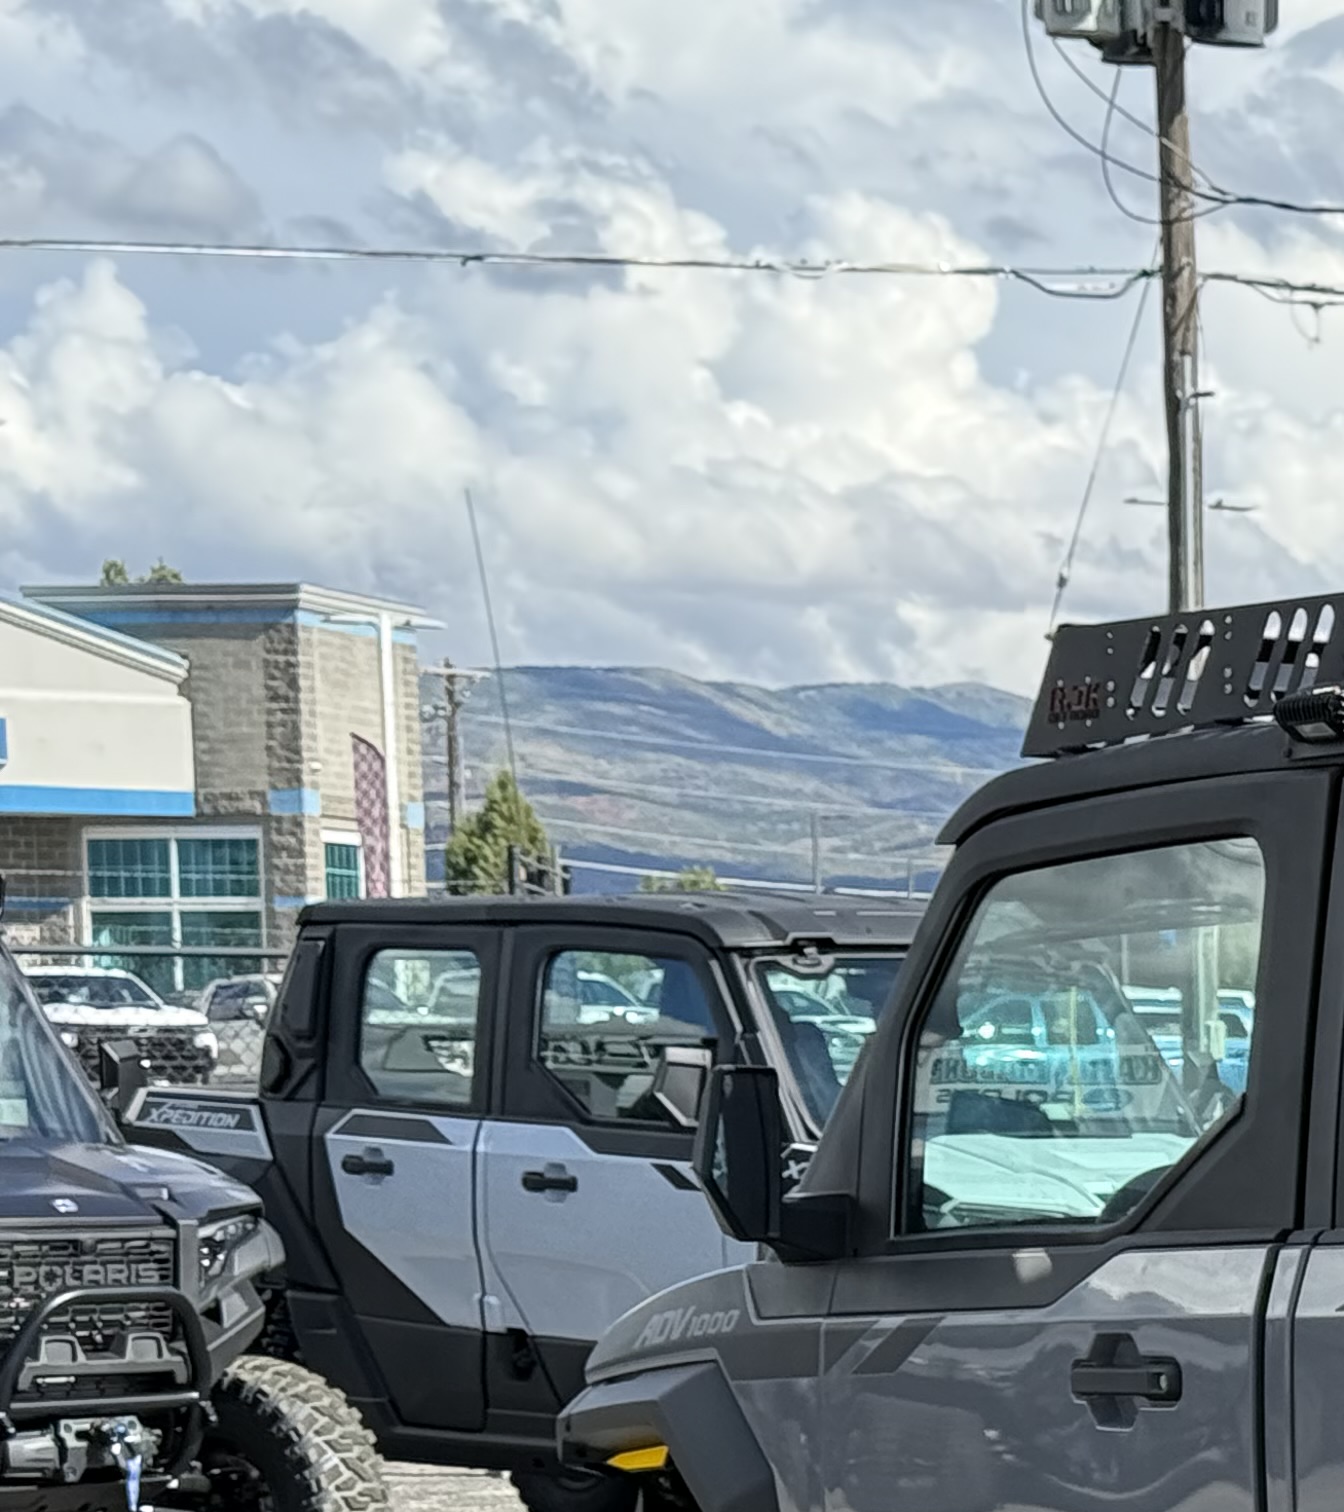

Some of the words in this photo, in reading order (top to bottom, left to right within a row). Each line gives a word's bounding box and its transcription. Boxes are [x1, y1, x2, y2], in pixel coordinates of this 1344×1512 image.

[147, 1101, 240, 1128] XPEDITION
[13, 1262, 160, 1292] POLARIS
[631, 1305, 697, 1350] ADV
[686, 1309, 742, 1339] 1000
